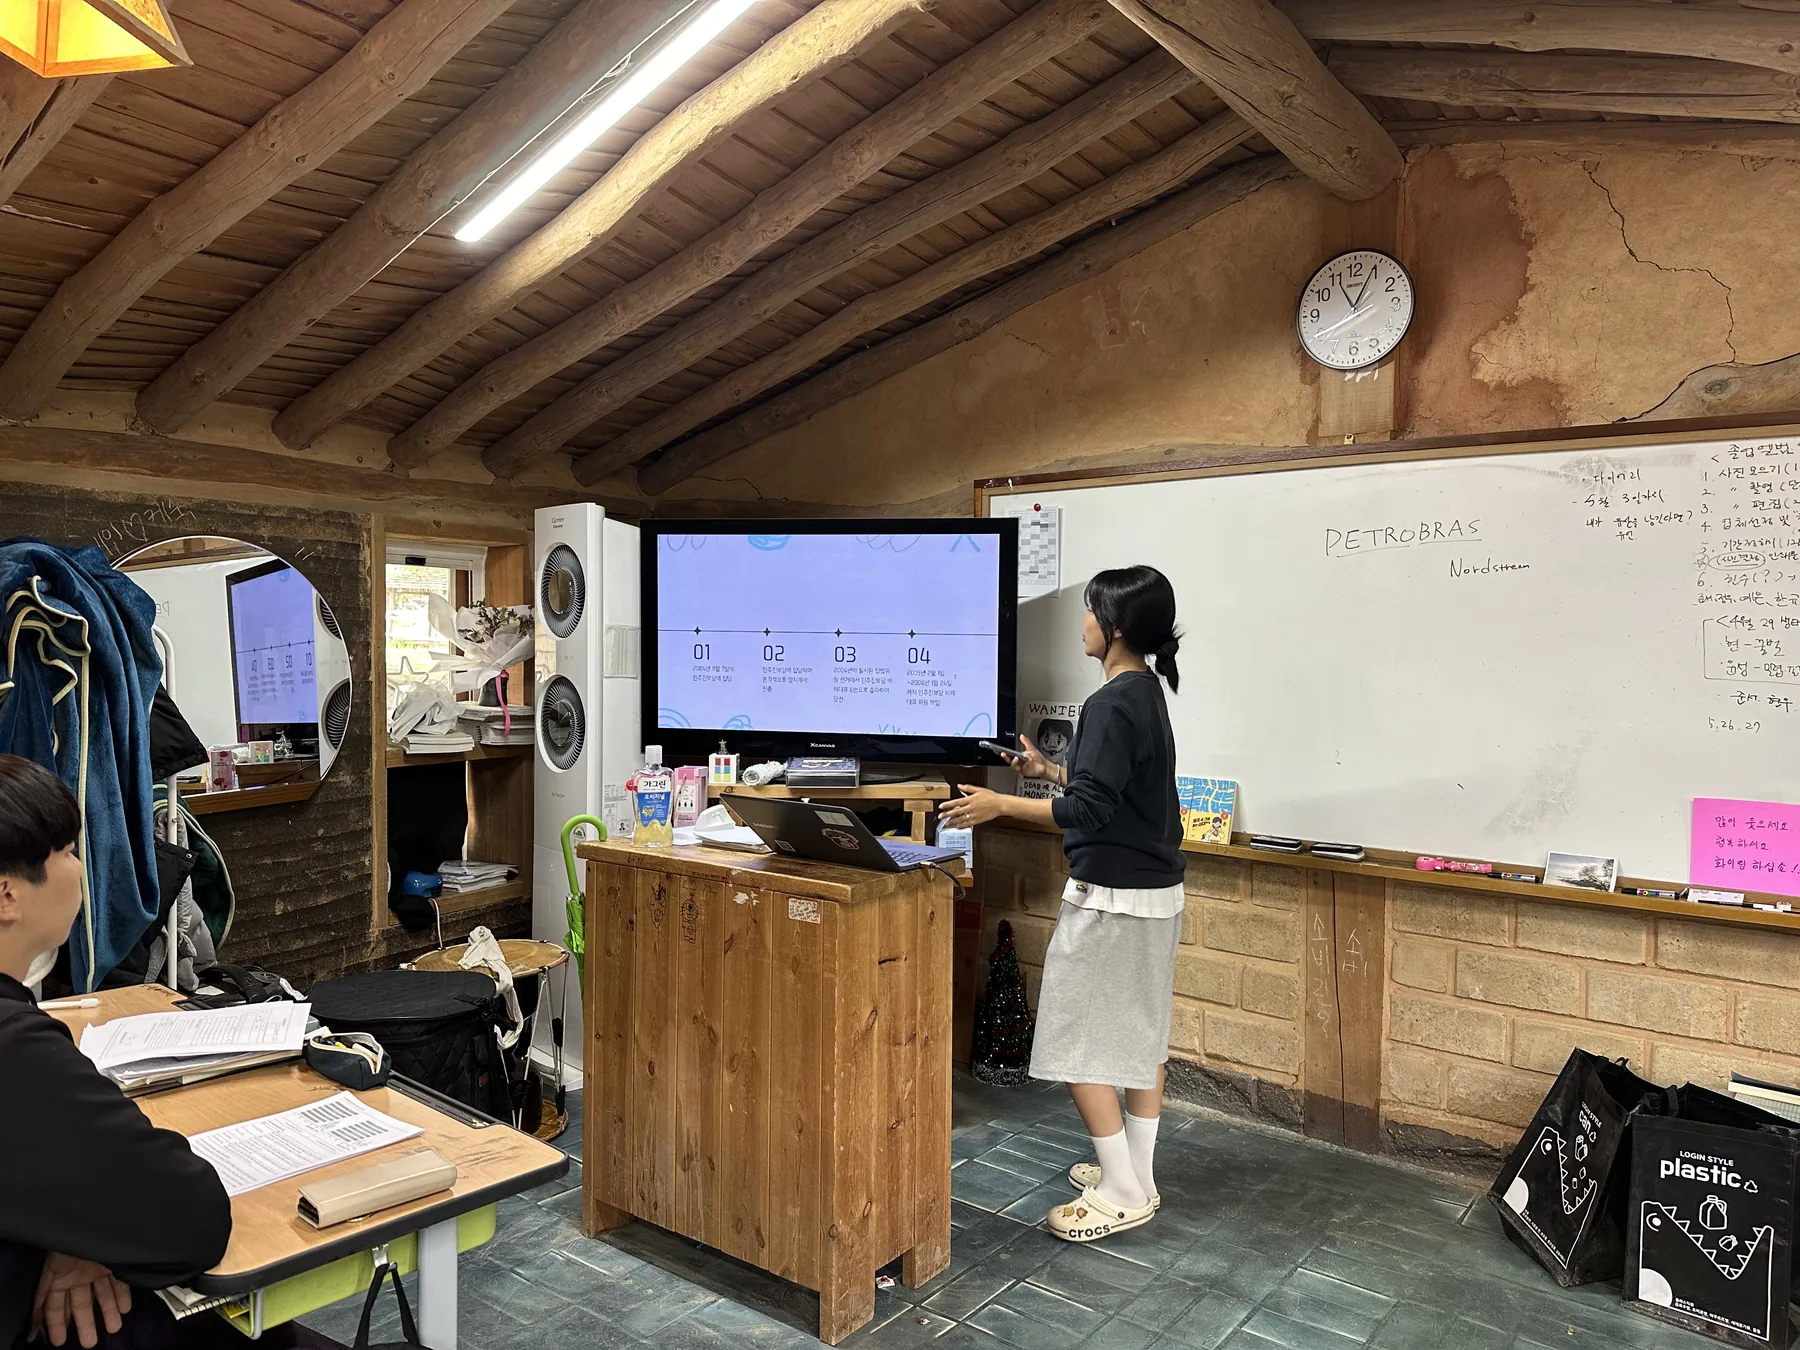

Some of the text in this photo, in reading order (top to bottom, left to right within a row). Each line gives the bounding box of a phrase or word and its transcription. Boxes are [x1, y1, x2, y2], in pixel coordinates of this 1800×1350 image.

[1346, 262, 1363, 278] 12
[1373, 264, 1378, 279] 1
[1328, 271, 1342, 287] 11
[1384, 277, 1396, 293] 2
[1315, 287, 1331, 302] 10
[1390, 296, 1402, 313] 3
[1310, 308, 1320, 323] 9
[1384, 317, 1395, 332] 4
[1330, 339, 1340, 355] 7
[1348, 341, 1359, 356] 6
[1718, 465, 1745, 480] 사진
[1325, 518, 1481, 556] PETROBRAS
[1760, 618, 1775, 630] 29
[693, 643, 710, 661] 01
[763, 644, 785, 662] 02
[834, 646, 856, 663] 03
[908, 646, 931, 665] 04
[643, 779, 666, 789] 가그린
[1023, 781, 1041, 791] DEAD
[1714, 815, 1736, 828] 많이
[1578, 1110, 1591, 1135] can
[1679, 1150, 1734, 1167] LOGIN STYLE
[1659, 1157, 1742, 1189] plastic
[1068, 1224, 1111, 1239] crocs
